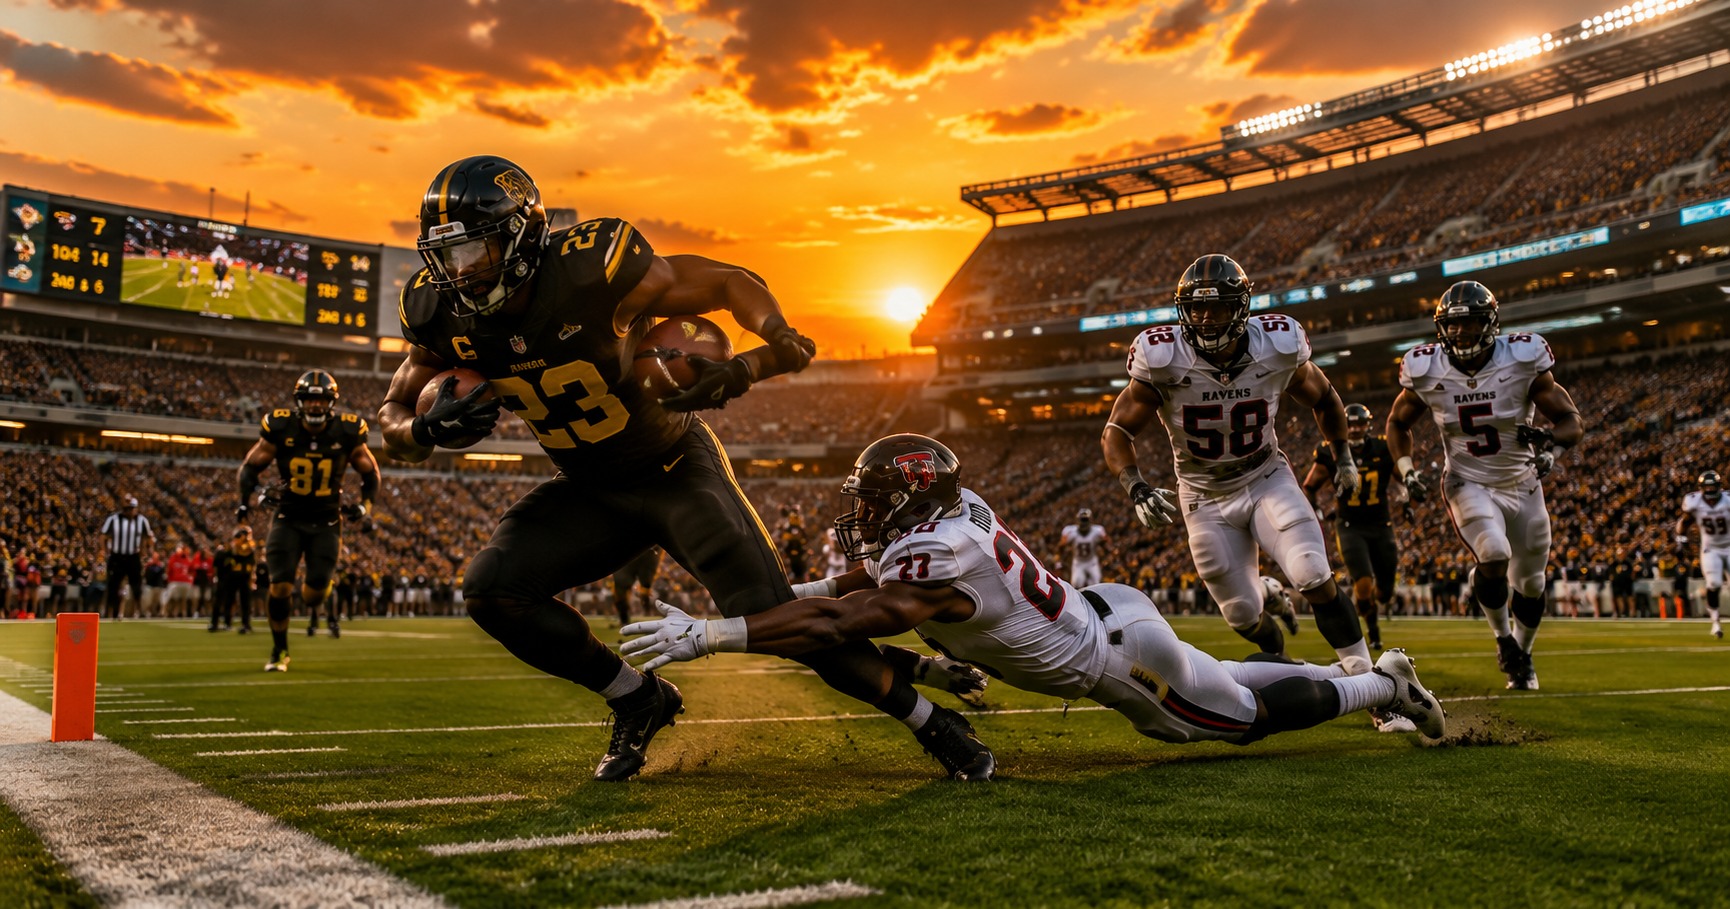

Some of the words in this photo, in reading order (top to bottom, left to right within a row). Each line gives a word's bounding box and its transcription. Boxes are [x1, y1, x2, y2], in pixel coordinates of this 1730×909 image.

[90, 216, 107, 236] 7
[561, 220, 602, 256] 23
[452, 335, 478, 360] C
[490, 359, 631, 449] 23
[1202, 387, 1251, 402] RAVENS
[1453, 390, 1496, 404] RAVENS
[1182, 398, 1269, 461] 58
[1458, 402, 1502, 458] 5
[289, 456, 333, 497] 81
[894, 552, 931, 580] 27
